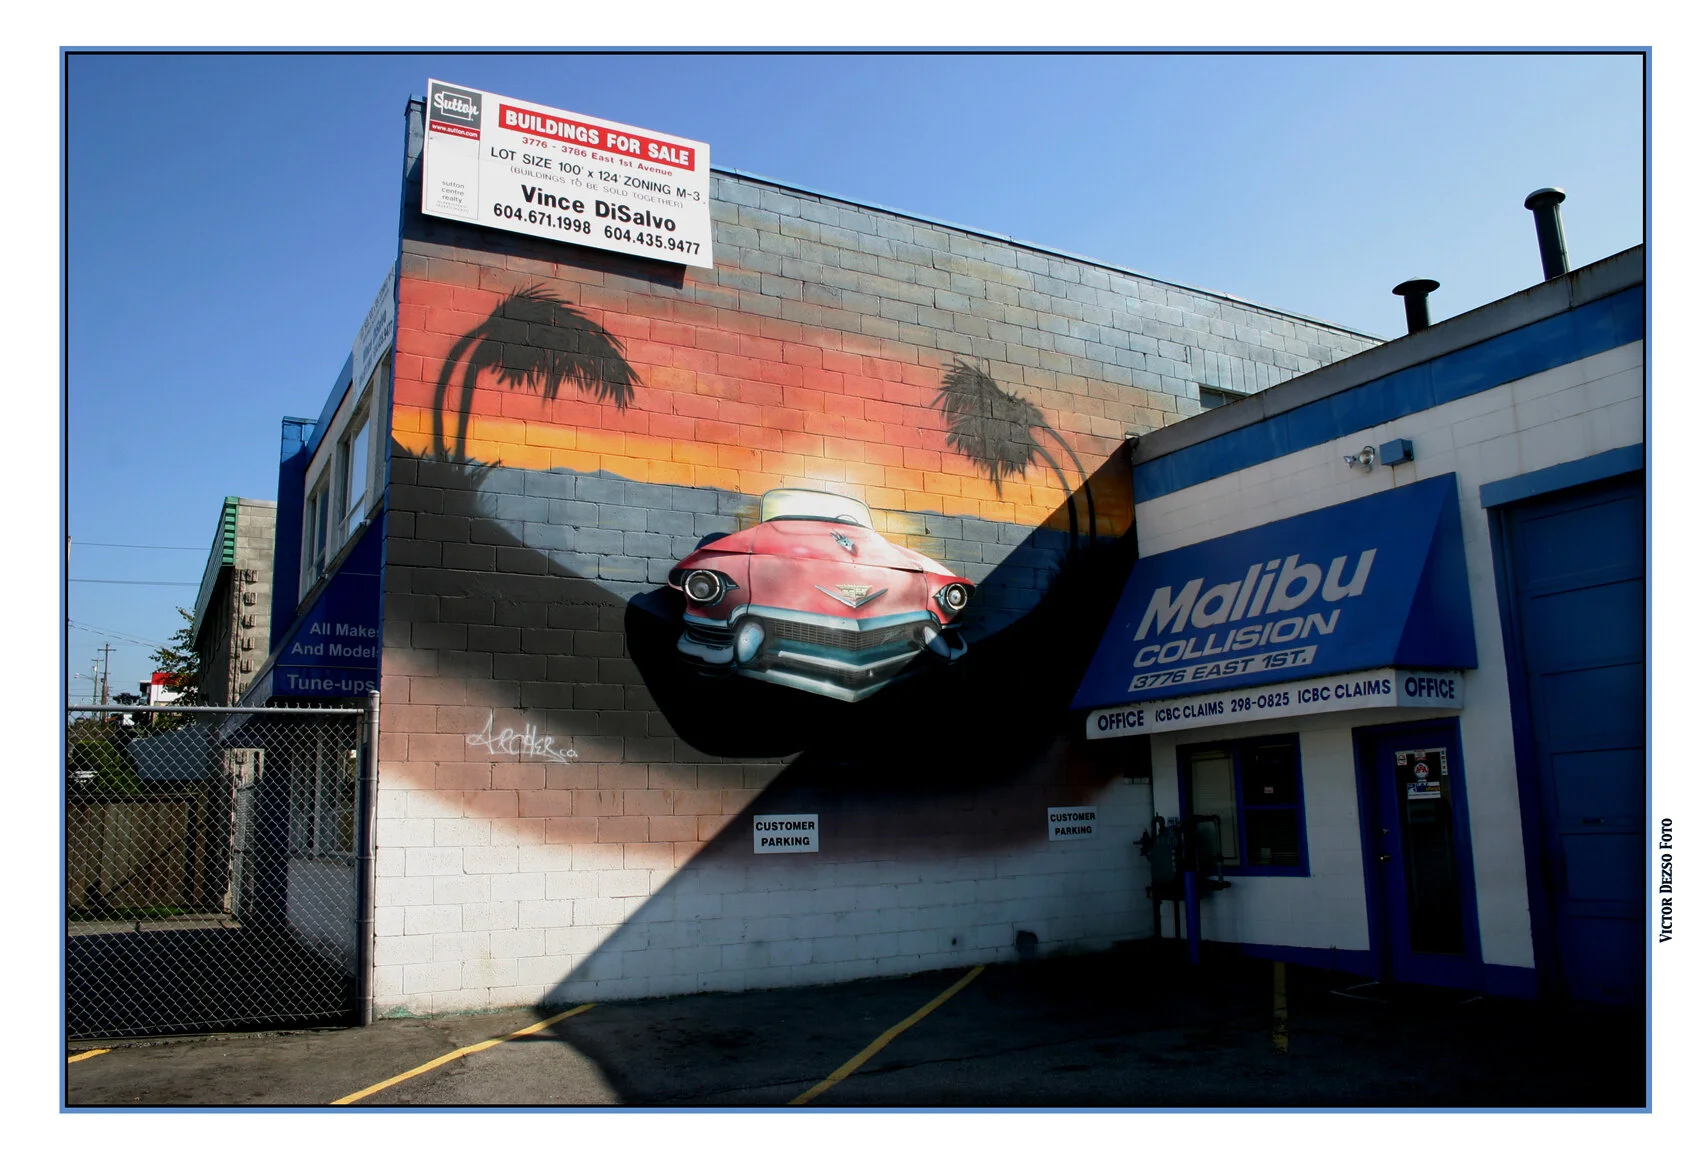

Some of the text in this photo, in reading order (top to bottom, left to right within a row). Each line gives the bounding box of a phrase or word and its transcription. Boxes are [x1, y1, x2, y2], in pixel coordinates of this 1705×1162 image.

[433, 93, 479, 115] Sutton
[431, 123, 478, 138] www.sutton.com
[505, 109, 690, 166] BUILDINGS FOR SALE
[522, 136, 548, 149] 3776
[561, 145, 587, 158] 3786
[591, 152, 614, 164] East
[619, 158, 633, 168] 1st
[638, 163, 673, 177] Avenue
[490, 146, 701, 201] LOT SIZE 100' x 124' ZONING M-3
[511, 165, 566, 184] (BUILDINGS
[571, 178, 582, 188] TO
[586, 183, 599, 191] BE
[603, 186, 628, 197] SOLD
[441, 181, 465, 189] sutton
[441, 188, 465, 196] centre
[442, 195, 463, 203] realty
[521, 183, 677, 232] Vince DiSalvo
[493, 202, 591, 235] 604.671.1998
[604, 225, 701, 255] 604.435.9477
[1133, 548, 1378, 642] Malibu
[309, 622, 330, 635] All
[1133, 609, 1342, 668] COLLISION
[291, 642, 379, 658] And Model
[1133, 649, 1308, 689] 3776 EAST 1ST.
[286, 674, 376, 694] Tune-ups
[1404, 676, 1455, 699] OFFICE
[1097, 679, 1392, 732] OFFICE ICBC CLAIMS 298-0825 ICBC CLAIMS
[755, 821, 815, 831] CUSTOMER
[1050, 812, 1096, 822] CUSTOMER
[761, 837, 810, 847] PARKING
[1055, 826, 1093, 836] PARKING
